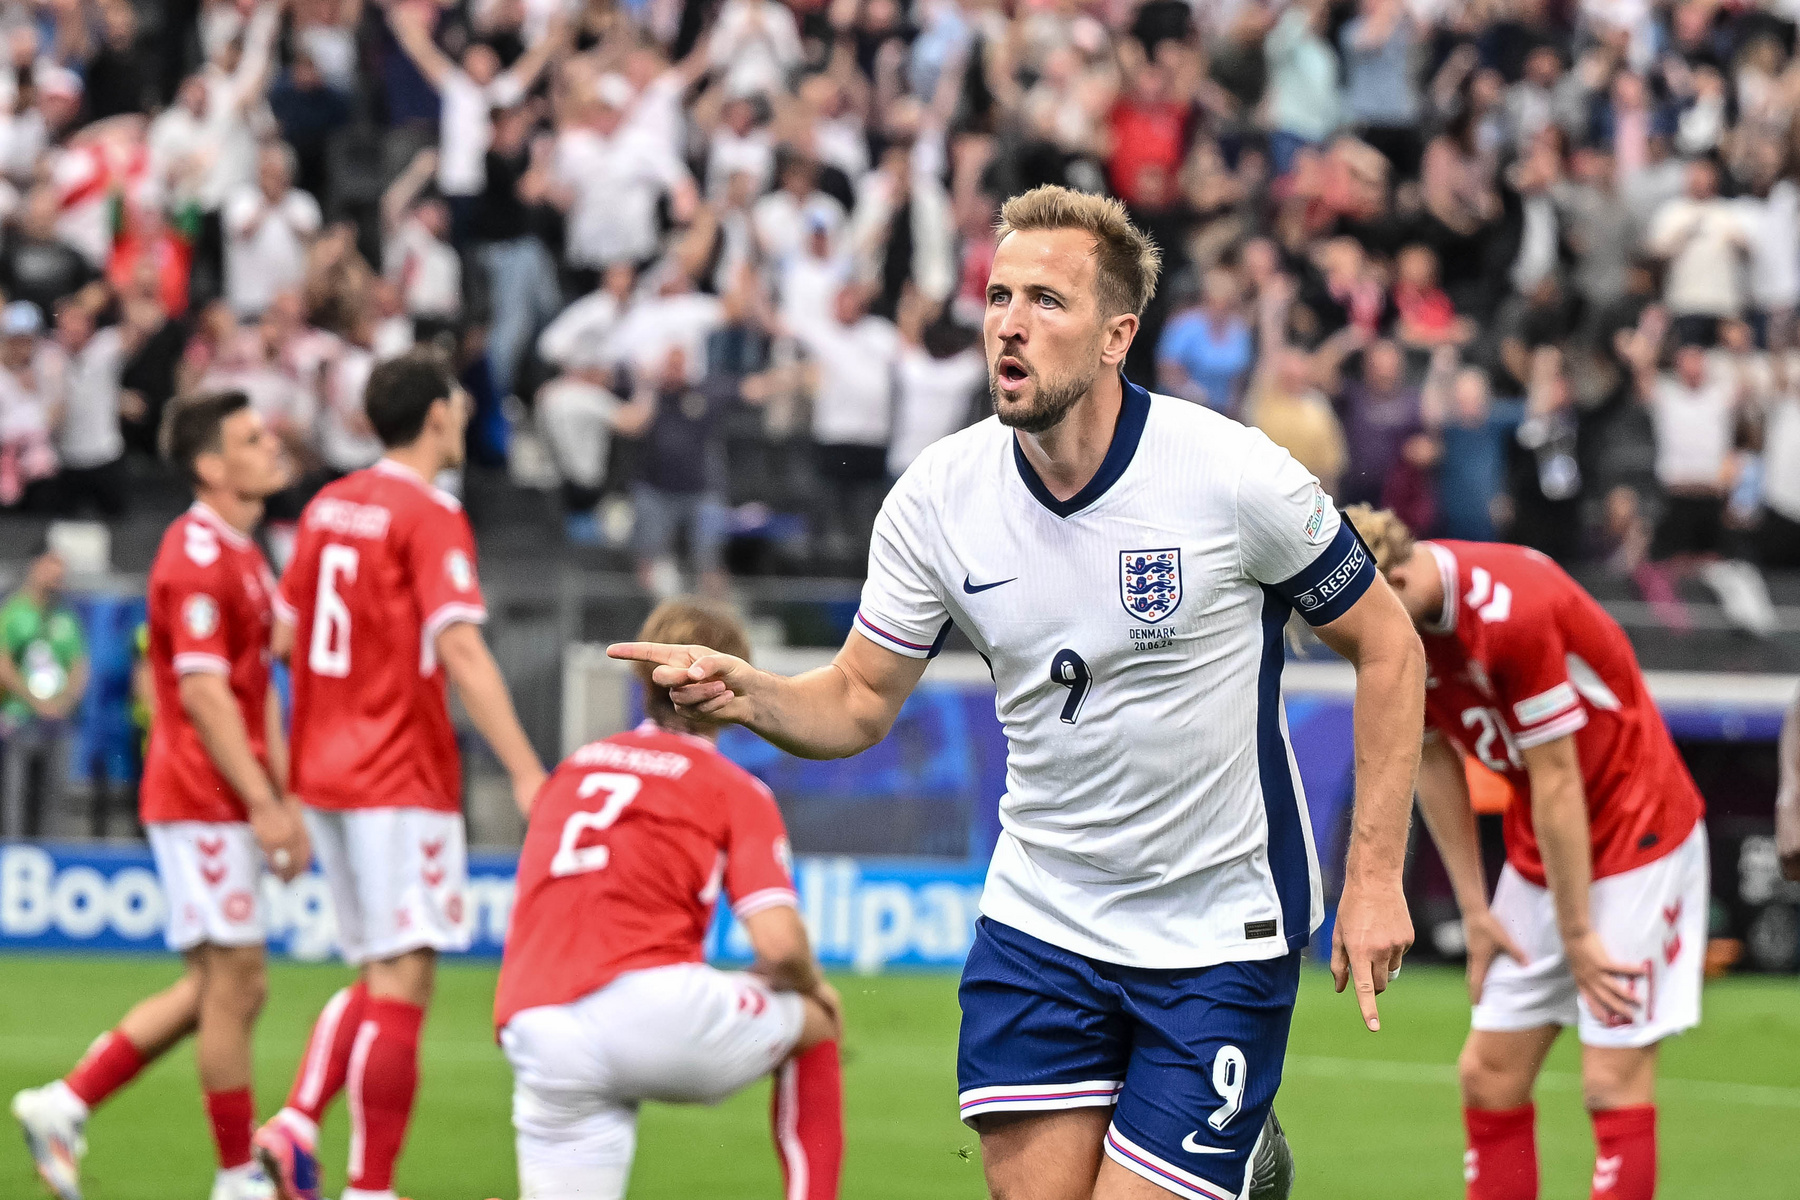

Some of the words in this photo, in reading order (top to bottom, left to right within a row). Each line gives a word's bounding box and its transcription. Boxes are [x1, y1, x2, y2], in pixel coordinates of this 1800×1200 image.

[310, 543, 359, 677] 6
[1129, 626, 1176, 640] DENMARK
[1134, 640, 1174, 651] 20.06.24
[1050, 649, 1093, 724] 9
[551, 771, 643, 878] 2
[1208, 1045, 1247, 1131] 9
